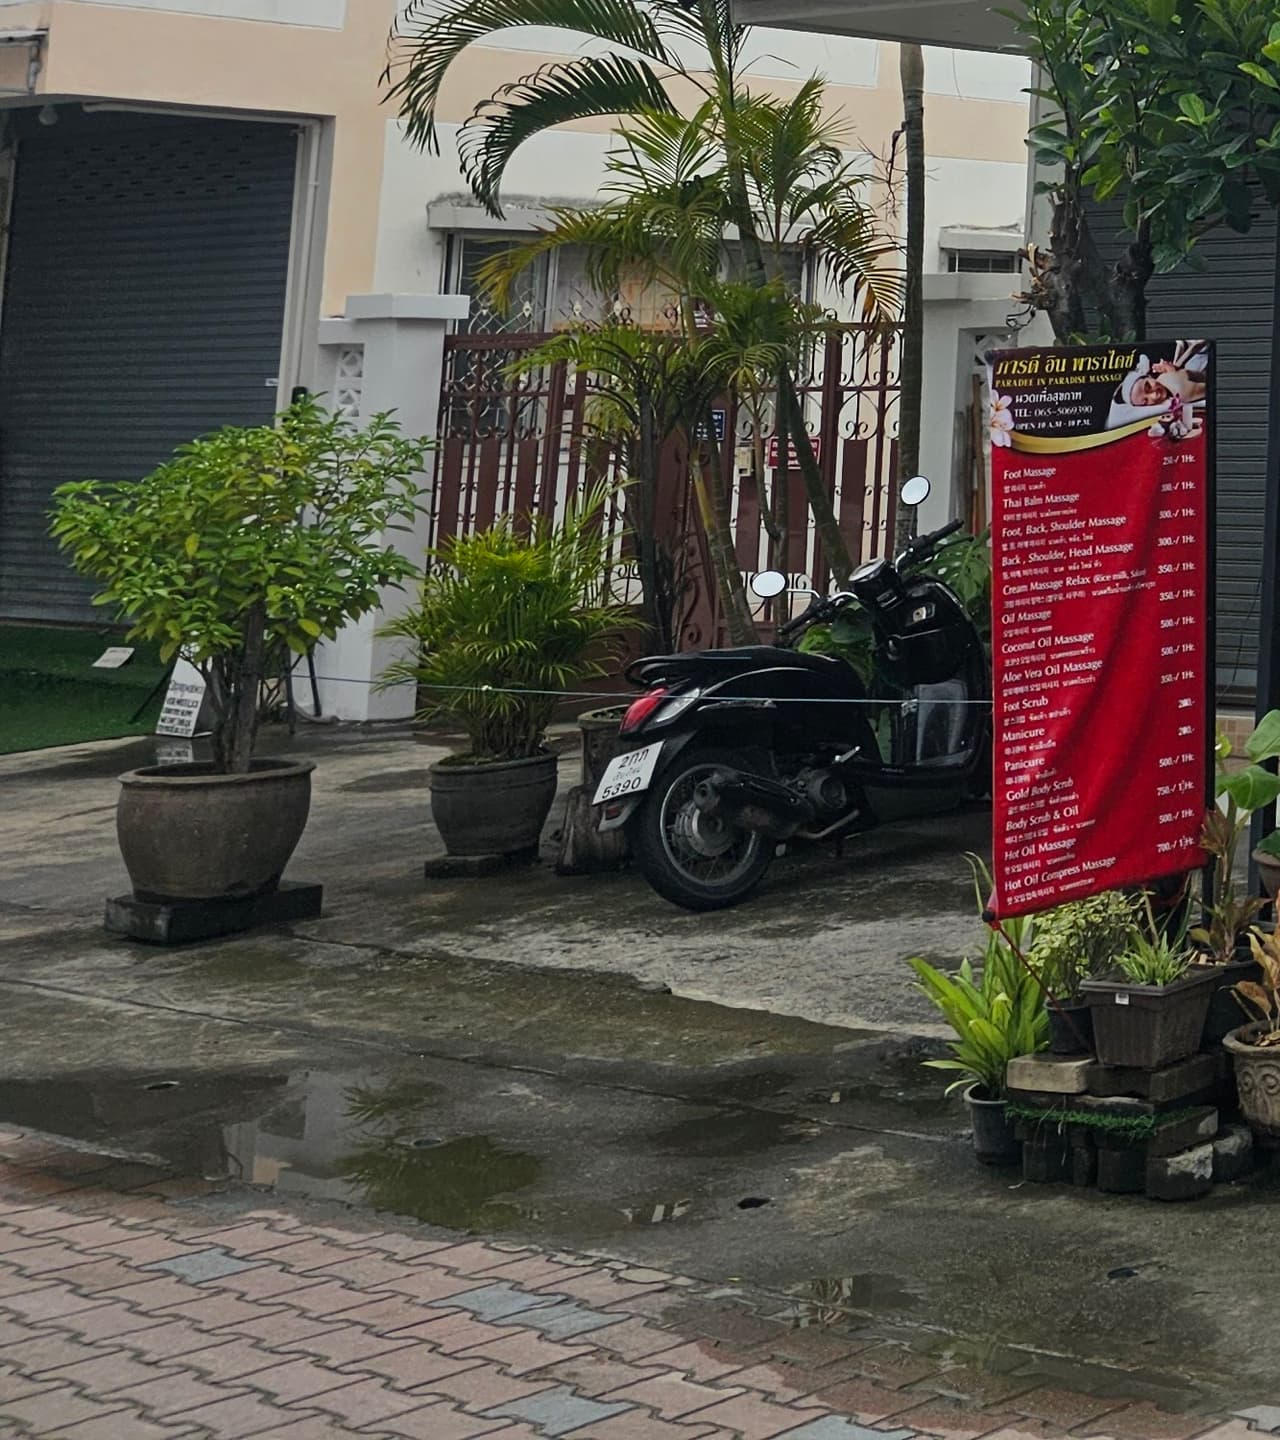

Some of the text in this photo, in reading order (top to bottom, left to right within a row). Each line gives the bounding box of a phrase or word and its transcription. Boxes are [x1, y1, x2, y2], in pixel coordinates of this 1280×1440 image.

[1045, 355, 1067, 373] อิน
[1003, 467, 1057, 479] Foot Massage
[1003, 498, 1022, 508] Thai
[1045, 494, 1080, 503] Massage
[1050, 519, 1086, 531] Shoulder
[1088, 516, 1126, 527] Massage
[1069, 545, 1093, 558] Head
[1095, 542, 1134, 555] Massage
[1003, 584, 1028, 595] Cream
[1030, 579, 1064, 592] Massage
[1066, 575, 1091, 587] Relax
[1002, 610, 1052, 624] Oil Massage
[1002, 633, 1095, 653] Coconut Oil Massage
[1002, 660, 1103, 683] Aloe Vera Oil Massage
[1003, 695, 1049, 712] Foot Scrub
[1002, 727, 1045, 742] Manicure
[1004, 757, 1045, 772] Panicure
[602, 776, 641, 799] 5390
[1006, 777, 1074, 801] Gold Body Scrub
[1006, 818, 1028, 831] Body
[1029, 811, 1051, 826] Scrub
[1063, 805, 1079, 817] Oil
[1005, 838, 1077, 861] Hot Oil Massage
[1005, 879, 1022, 892] Hot
[1024, 874, 1039, 886] Oil
[1041, 864, 1080, 883] Compress
[1082, 857, 1117, 872] Massage
